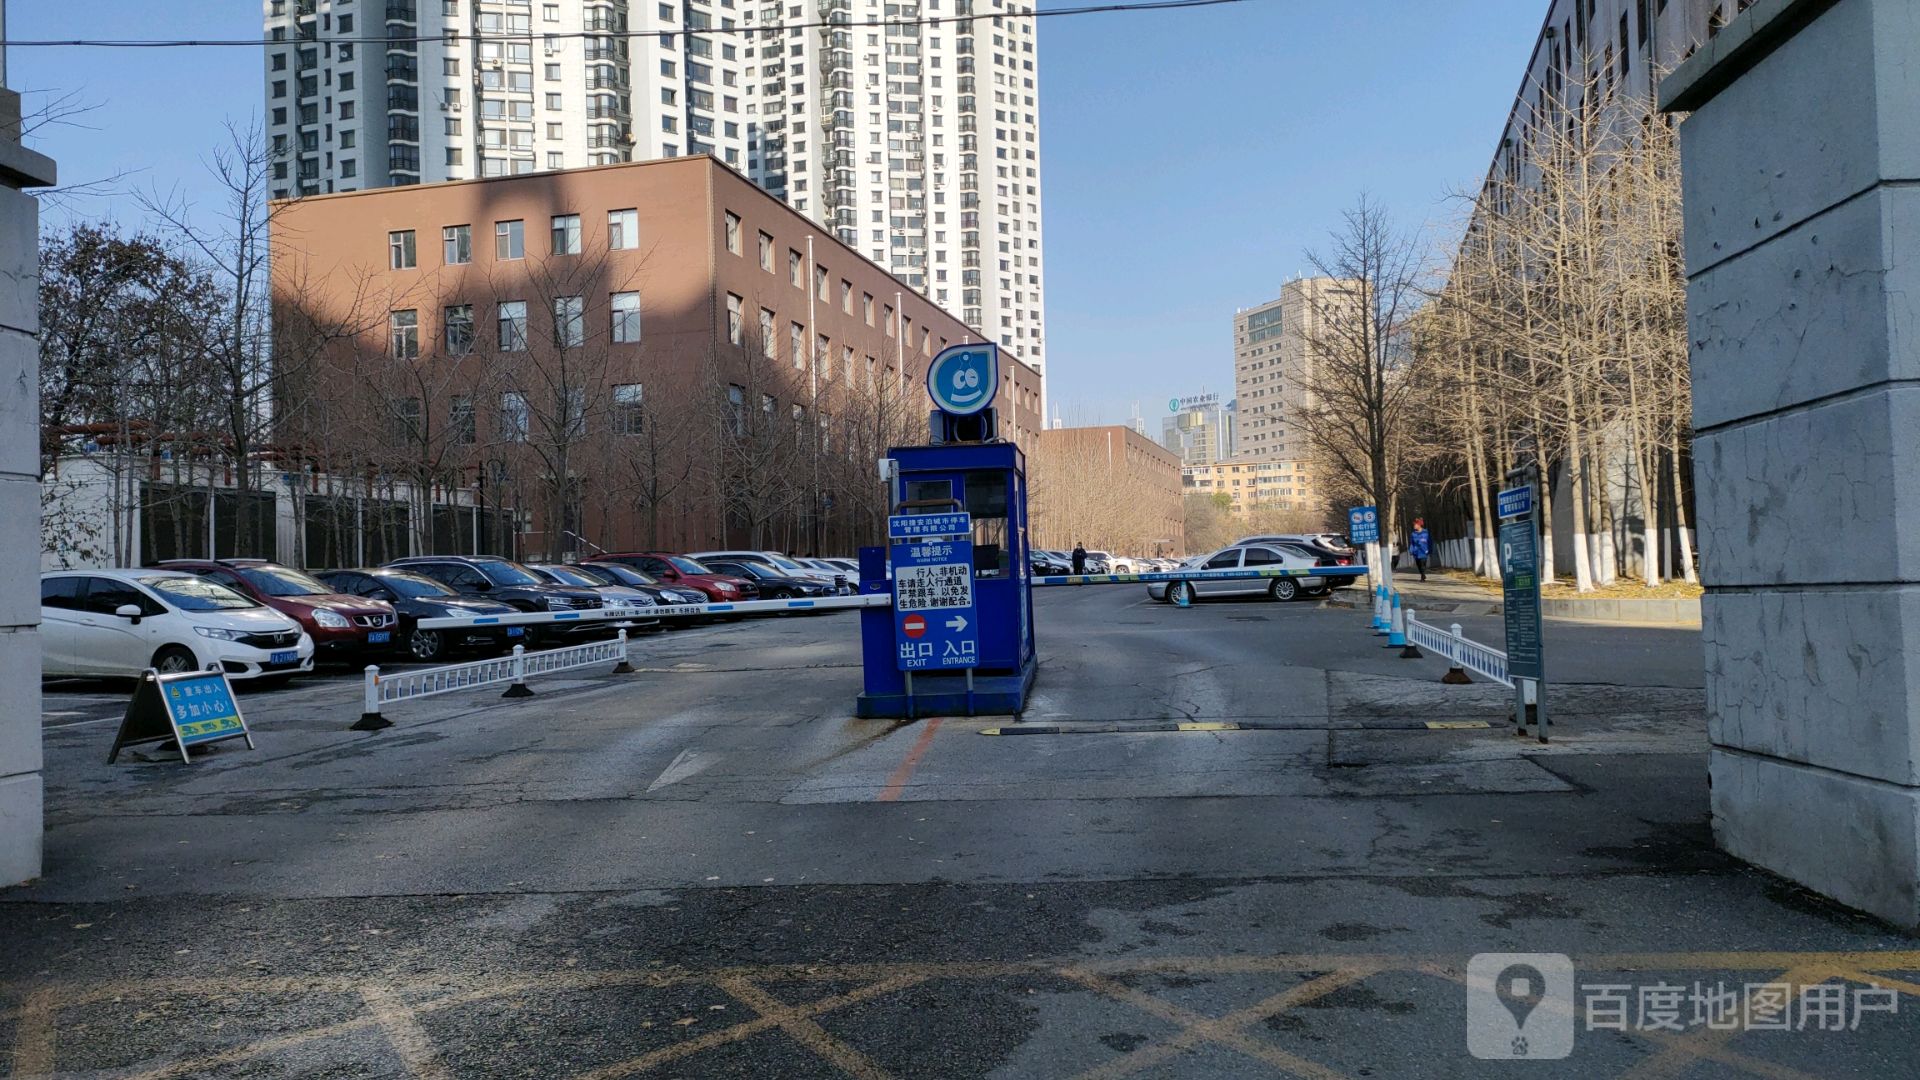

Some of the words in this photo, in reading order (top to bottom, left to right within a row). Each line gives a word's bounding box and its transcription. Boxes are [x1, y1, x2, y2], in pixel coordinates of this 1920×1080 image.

[1180, 392, 1219, 405] 中国农业银行
[904, 524, 956, 534] 管理有限公司
[910, 545, 953, 558] 温馨提示
[916, 565, 968, 578] 行人、非机动
[897, 576, 963, 588] 车请走人行通道
[900, 641, 933, 659] 出口
[942, 639, 975, 657] 入口
[906, 658, 927, 667] EXIT
[942, 656, 976, 665] ENTRANCE
